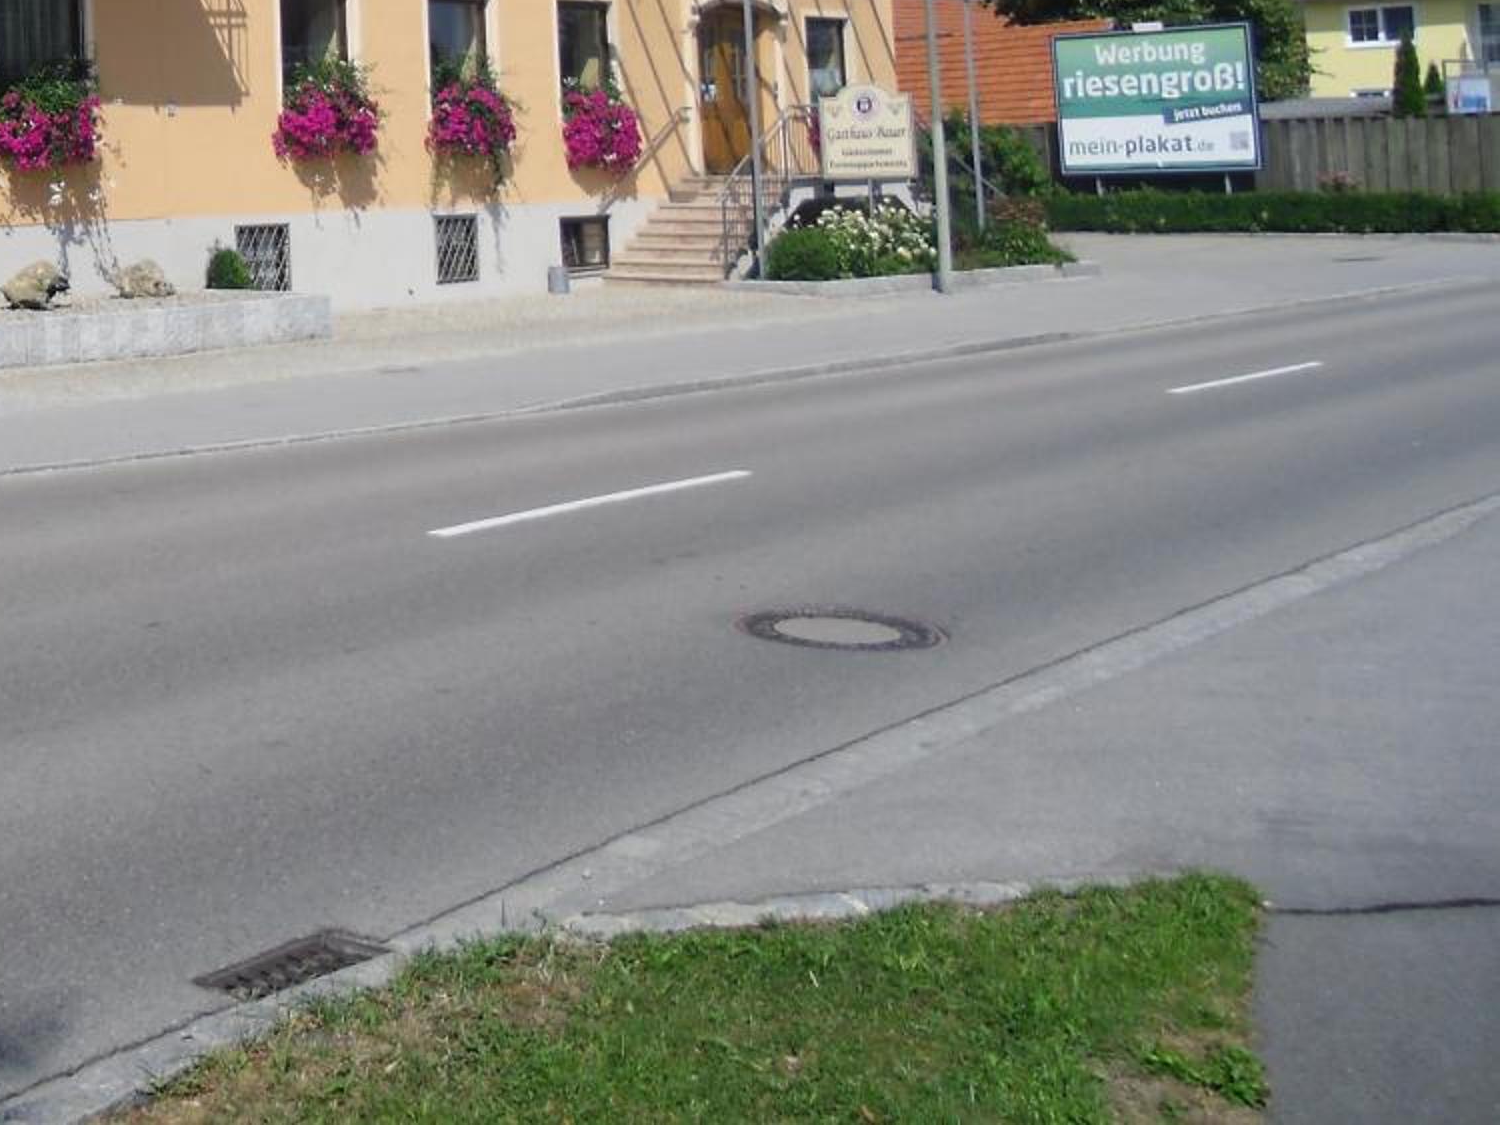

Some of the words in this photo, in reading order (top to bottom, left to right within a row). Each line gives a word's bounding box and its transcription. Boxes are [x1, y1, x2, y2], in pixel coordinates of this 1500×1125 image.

[1094, 42, 1206, 65] Werbung
[1063, 61, 1245, 98] riesengroß!
[1173, 107, 1200, 121] jetzt
[1202, 102, 1242, 117] buchen
[1069, 133, 1214, 158] mein-plakat.de
